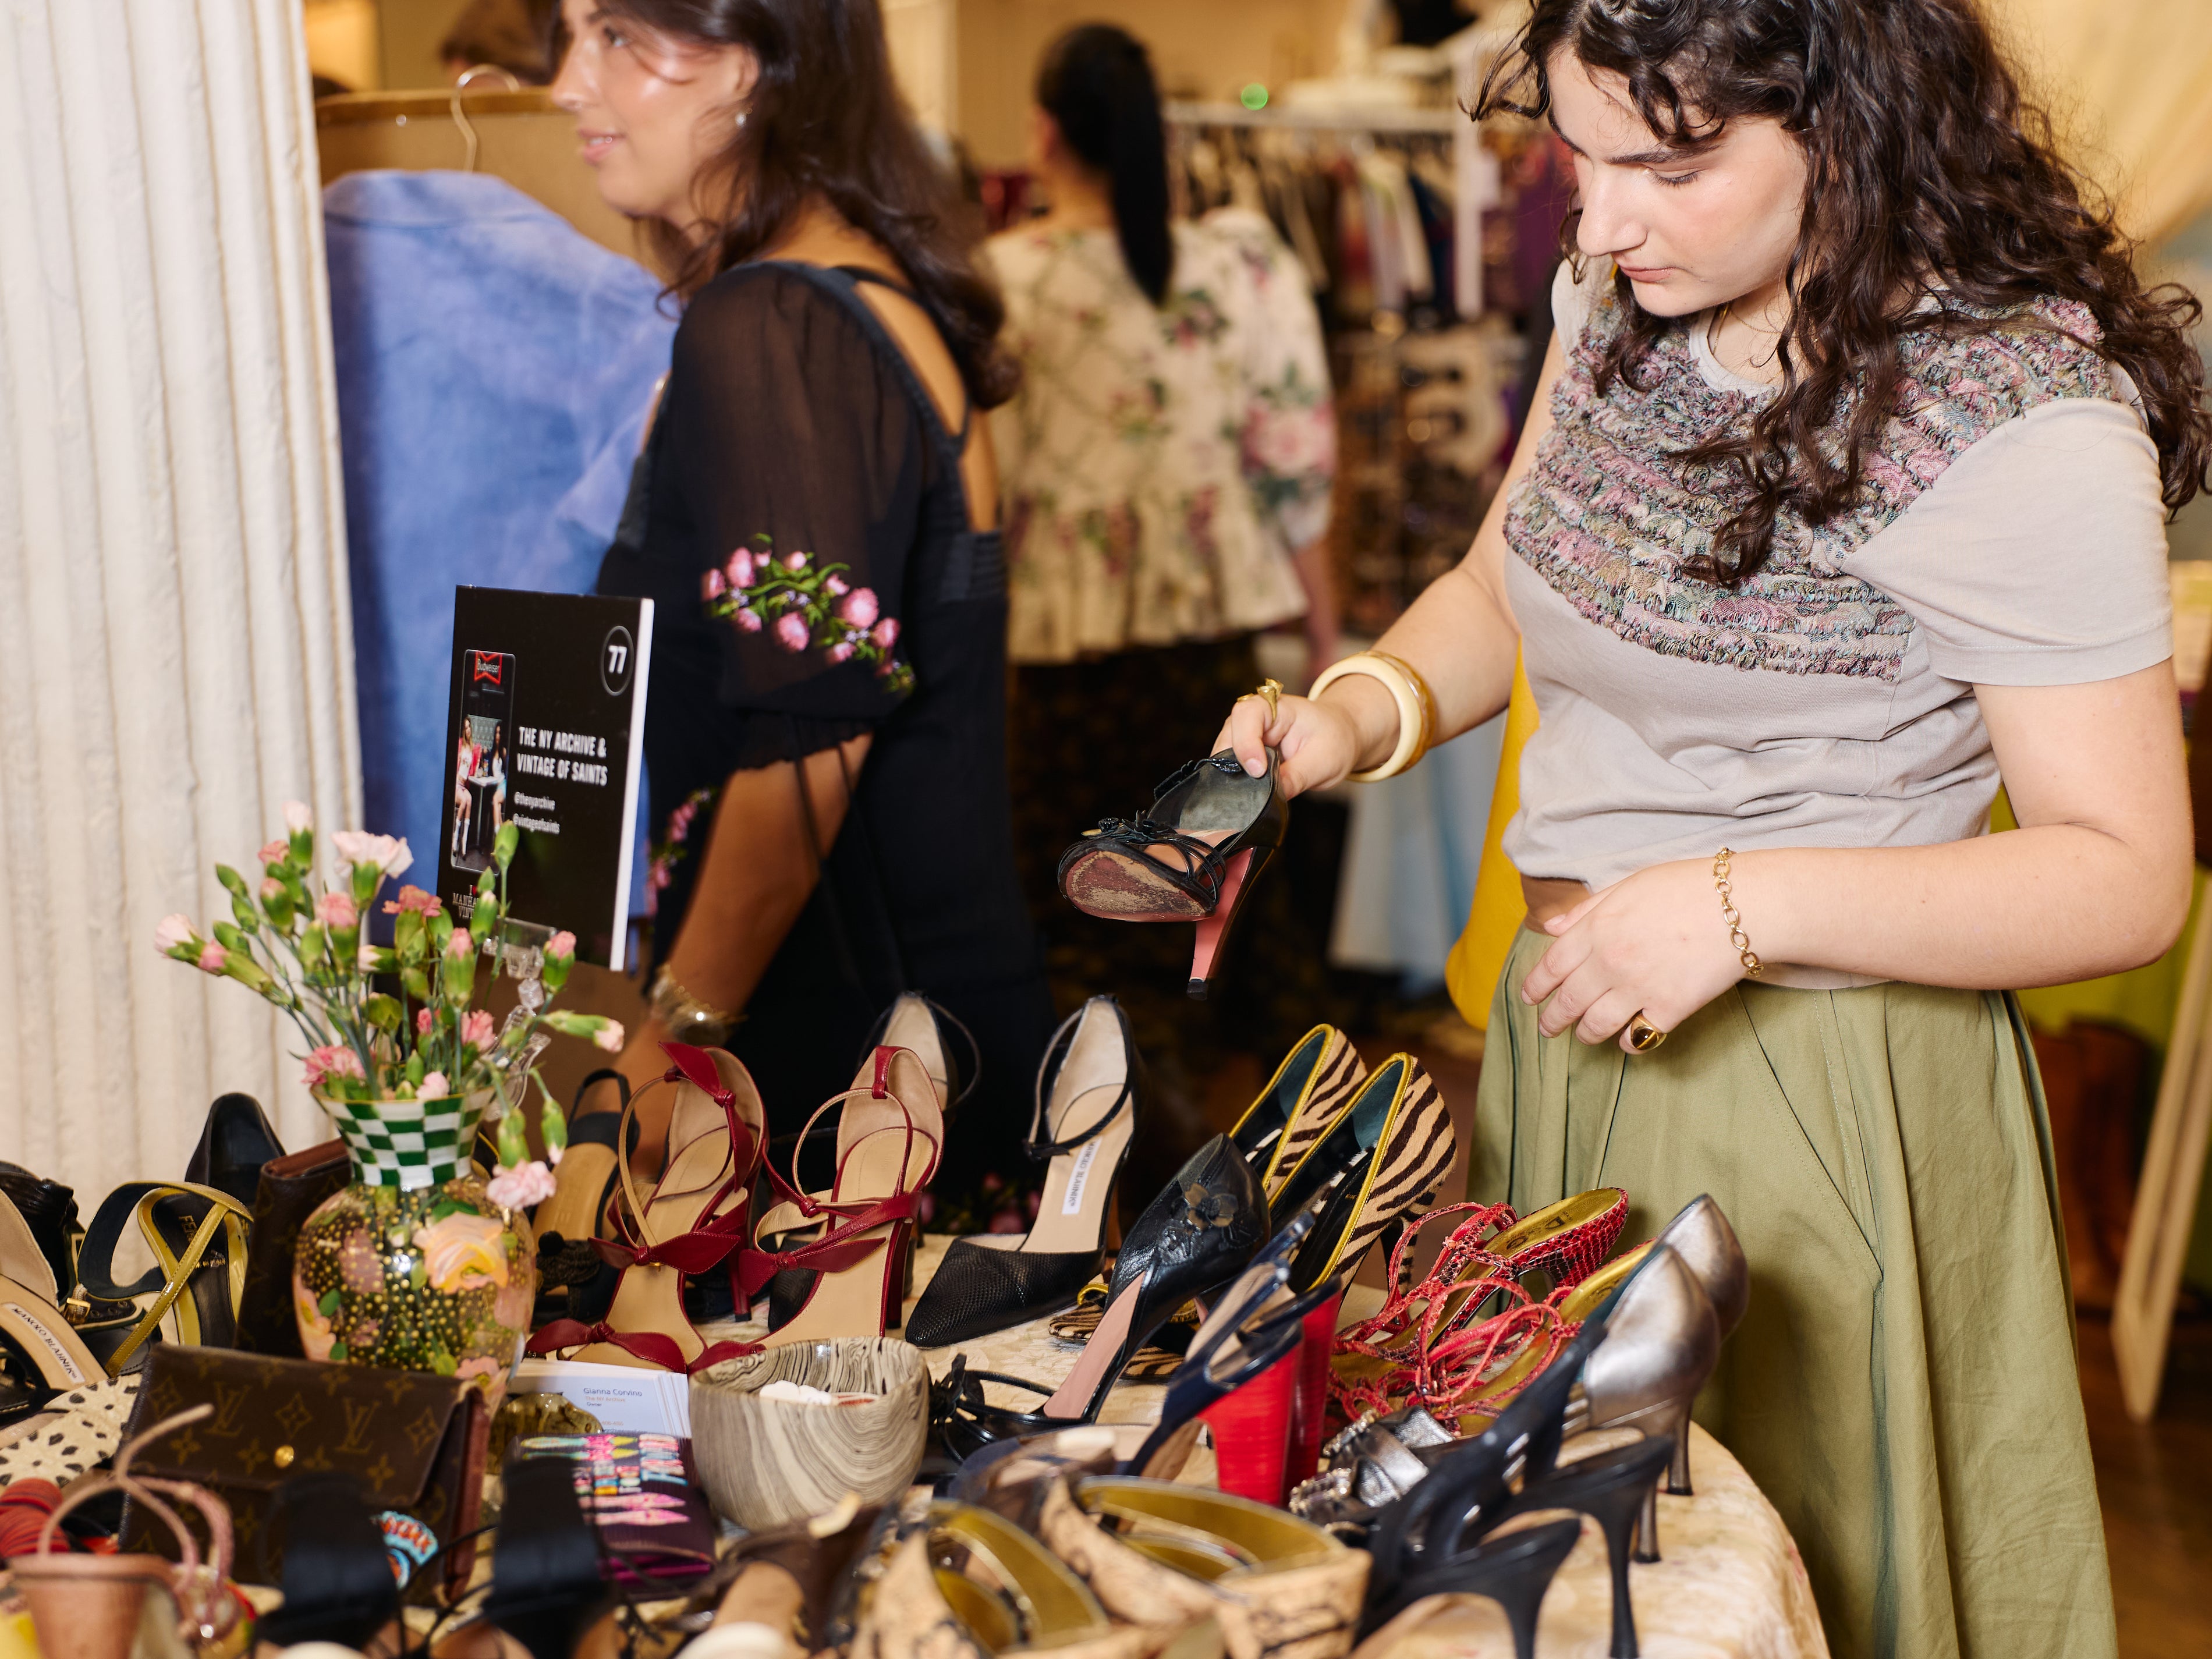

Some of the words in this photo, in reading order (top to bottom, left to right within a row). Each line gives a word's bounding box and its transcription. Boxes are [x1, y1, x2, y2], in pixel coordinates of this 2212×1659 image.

[608, 645, 627, 674] 77
[519, 726, 537, 747] THE
[538, 729, 552, 749] NY
[554, 732, 596, 756] ARCHIVE
[597, 738, 607, 758] &
[517, 753, 556, 777] VINTAGE
[557, 759, 570, 779] OF
[572, 761, 608, 786] SAINTS
[514, 792, 555, 811] @thenyarchive
[459, 906, 474, 919] VINT
[1079, 1141, 1096, 1170] MANOLO
[12, 1307, 47, 1336] MANOLO
[612, 1388, 643, 1396] Corvino
